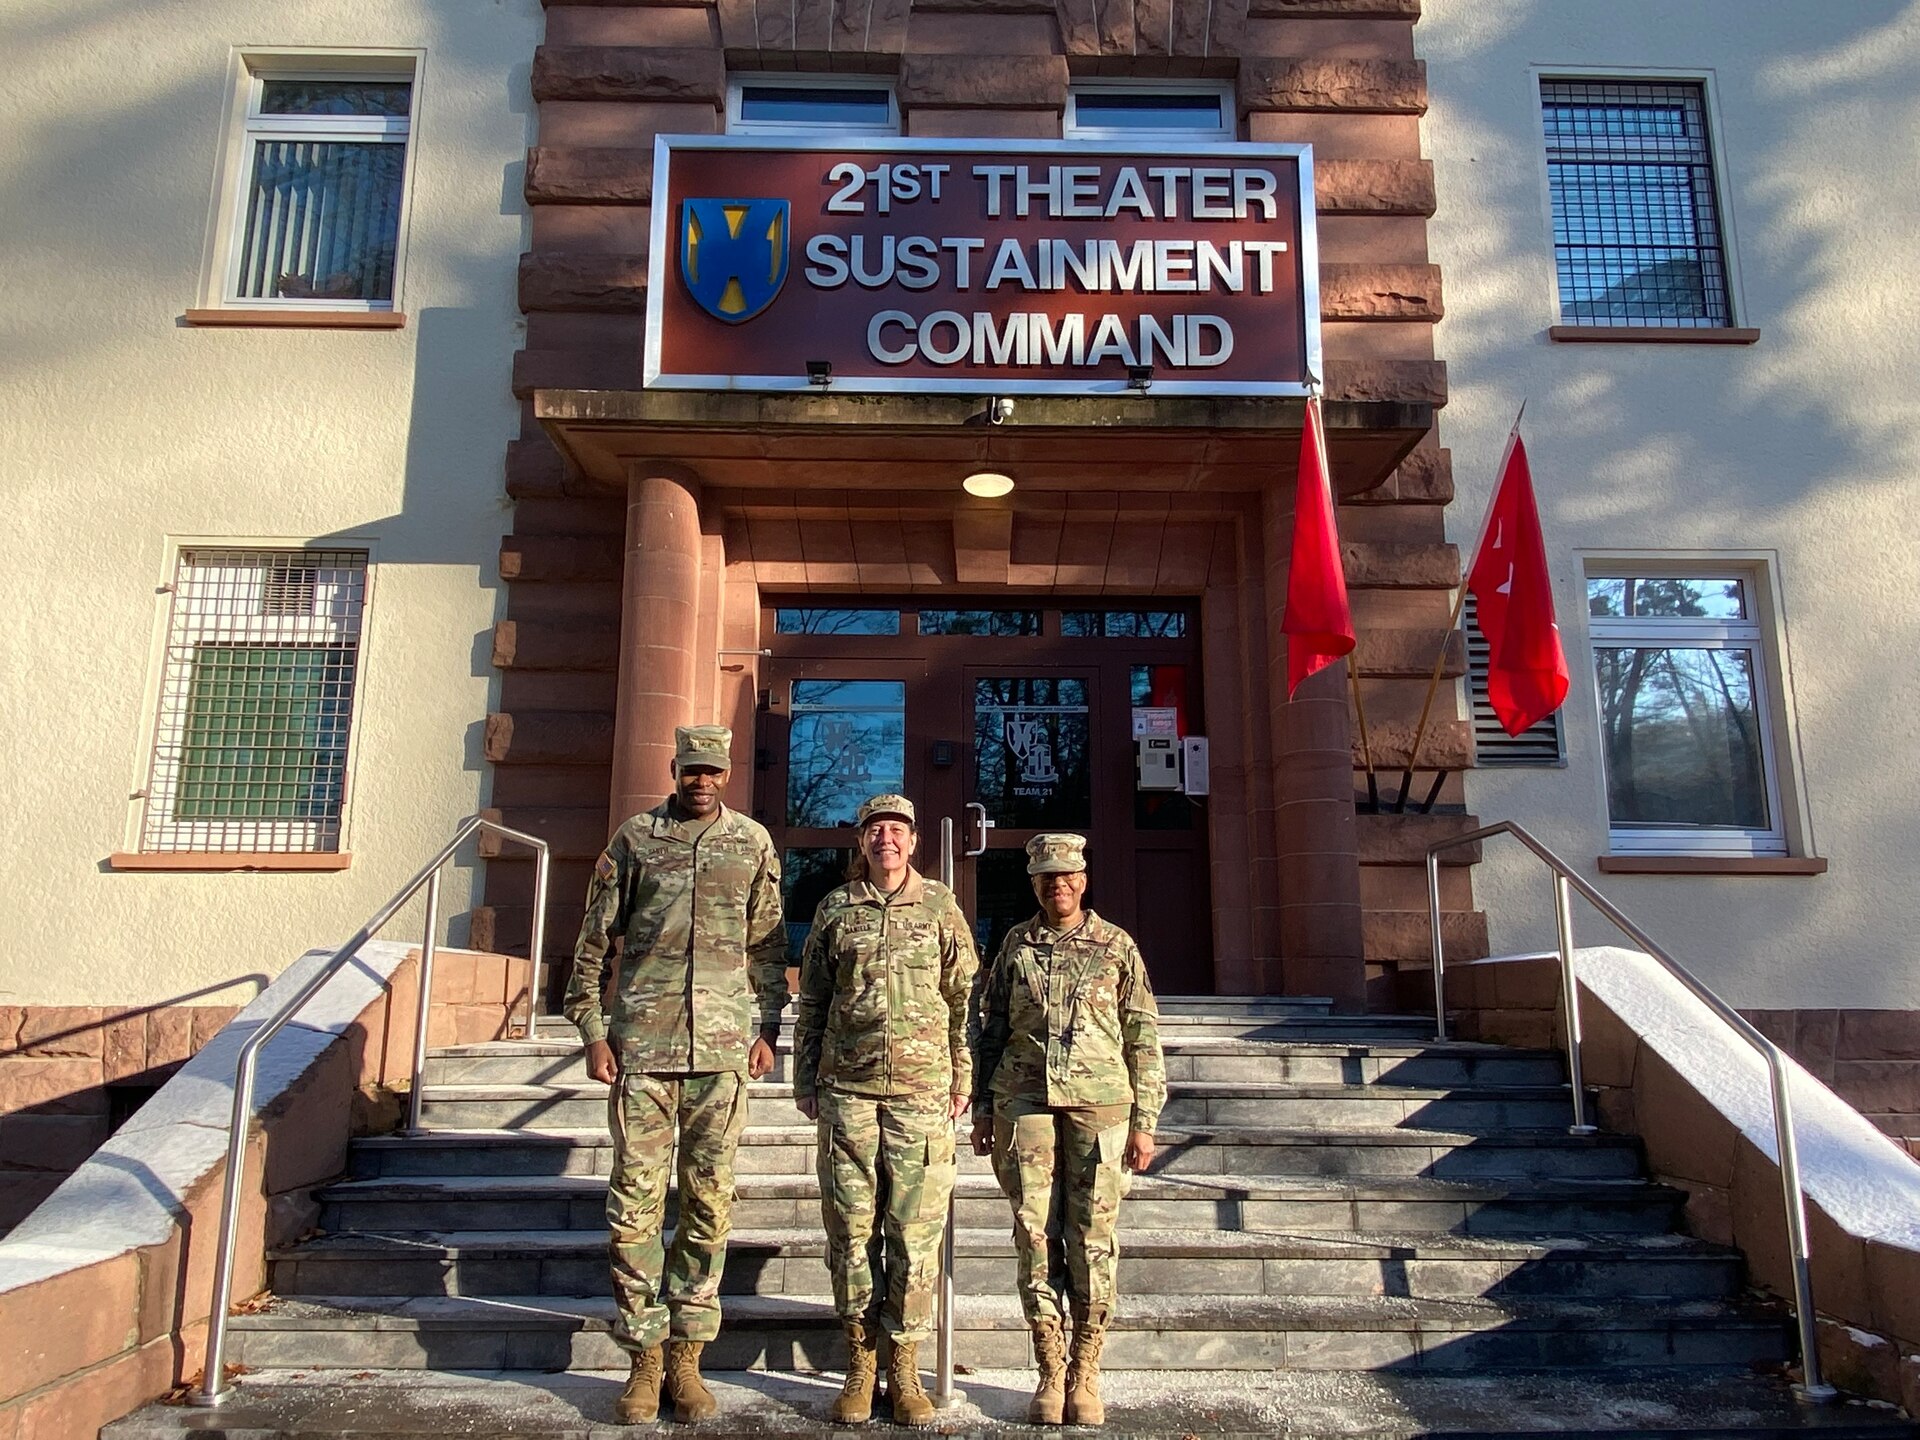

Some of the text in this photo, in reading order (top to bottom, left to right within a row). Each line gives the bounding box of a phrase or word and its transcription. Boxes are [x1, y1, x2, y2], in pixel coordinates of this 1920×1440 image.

[828, 162, 1278, 219] 21ST THEATER
[804, 234, 1287, 292] SUSTAINMENT
[866, 309, 1235, 367] COMMAND
[1013, 787, 1053, 796] TEAM 21
[844, 924, 871, 935] DANIELS
[914, 921, 932, 930] ARMY
